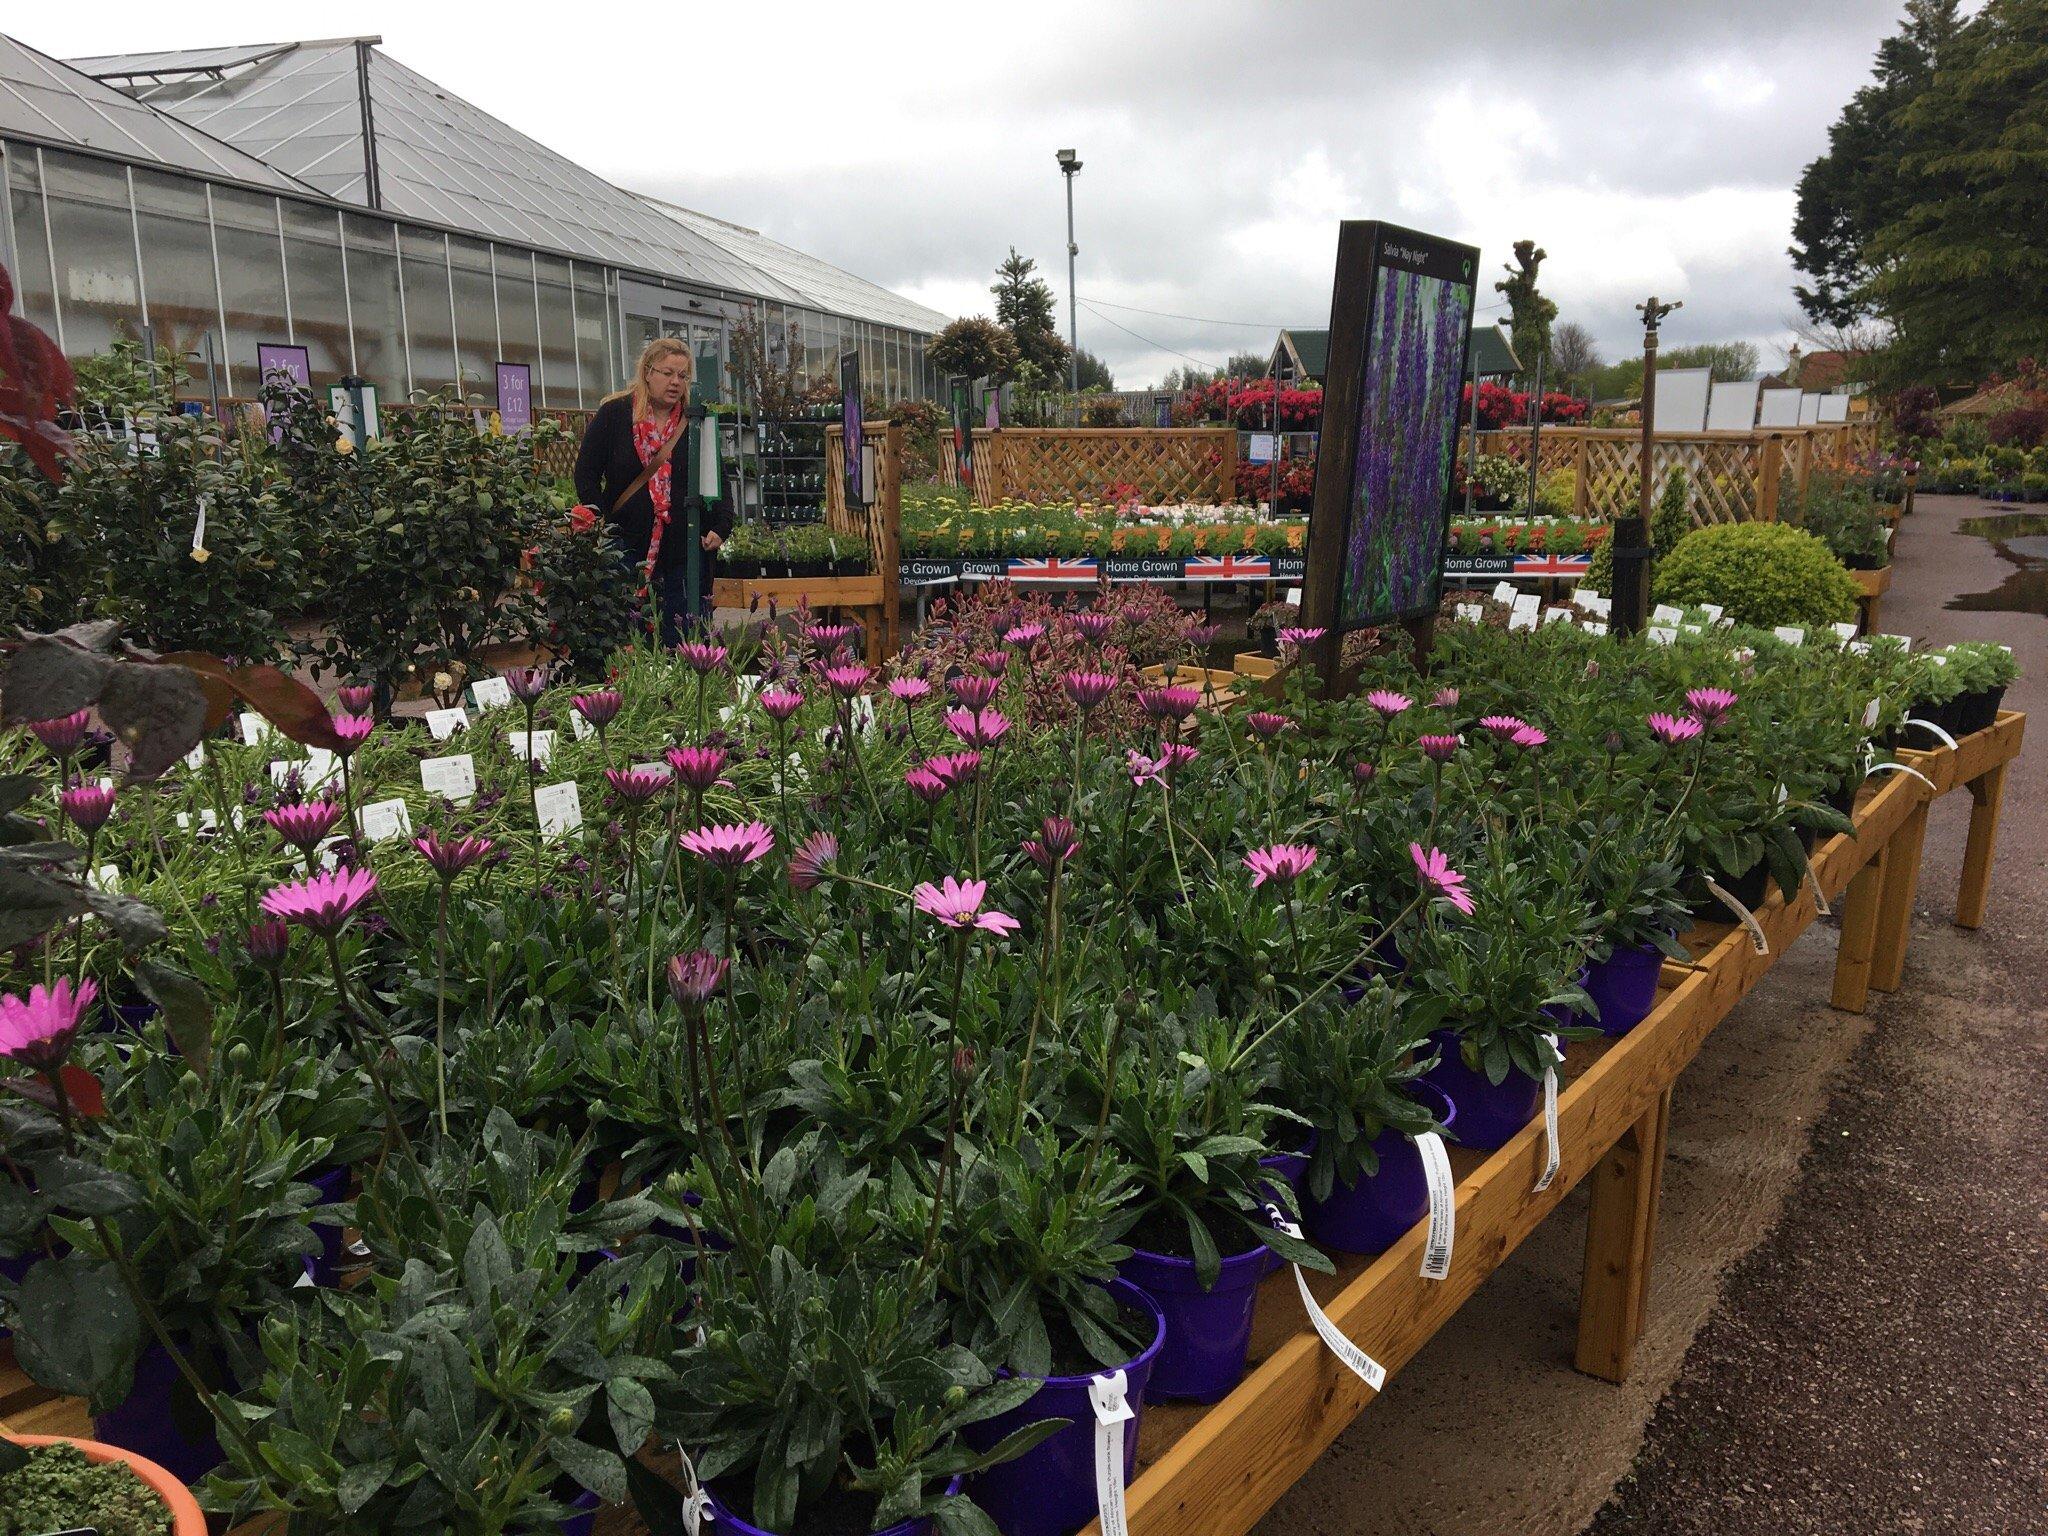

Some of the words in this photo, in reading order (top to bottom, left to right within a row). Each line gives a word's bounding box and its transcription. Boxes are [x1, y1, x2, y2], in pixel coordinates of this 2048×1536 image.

[1383, 242, 1399, 257] Salvia
[503, 374, 509, 390] 3
[511, 374, 525, 390] for
[507, 396, 523, 413] £12
[912, 562, 950, 574] Grown
[962, 561, 1000, 573] Grown
[1106, 559, 1139, 572] Home
[1142, 560, 1178, 572] Grown
[1278, 558, 1305, 570] Hom
[1475, 557, 1507, 569] Grown
